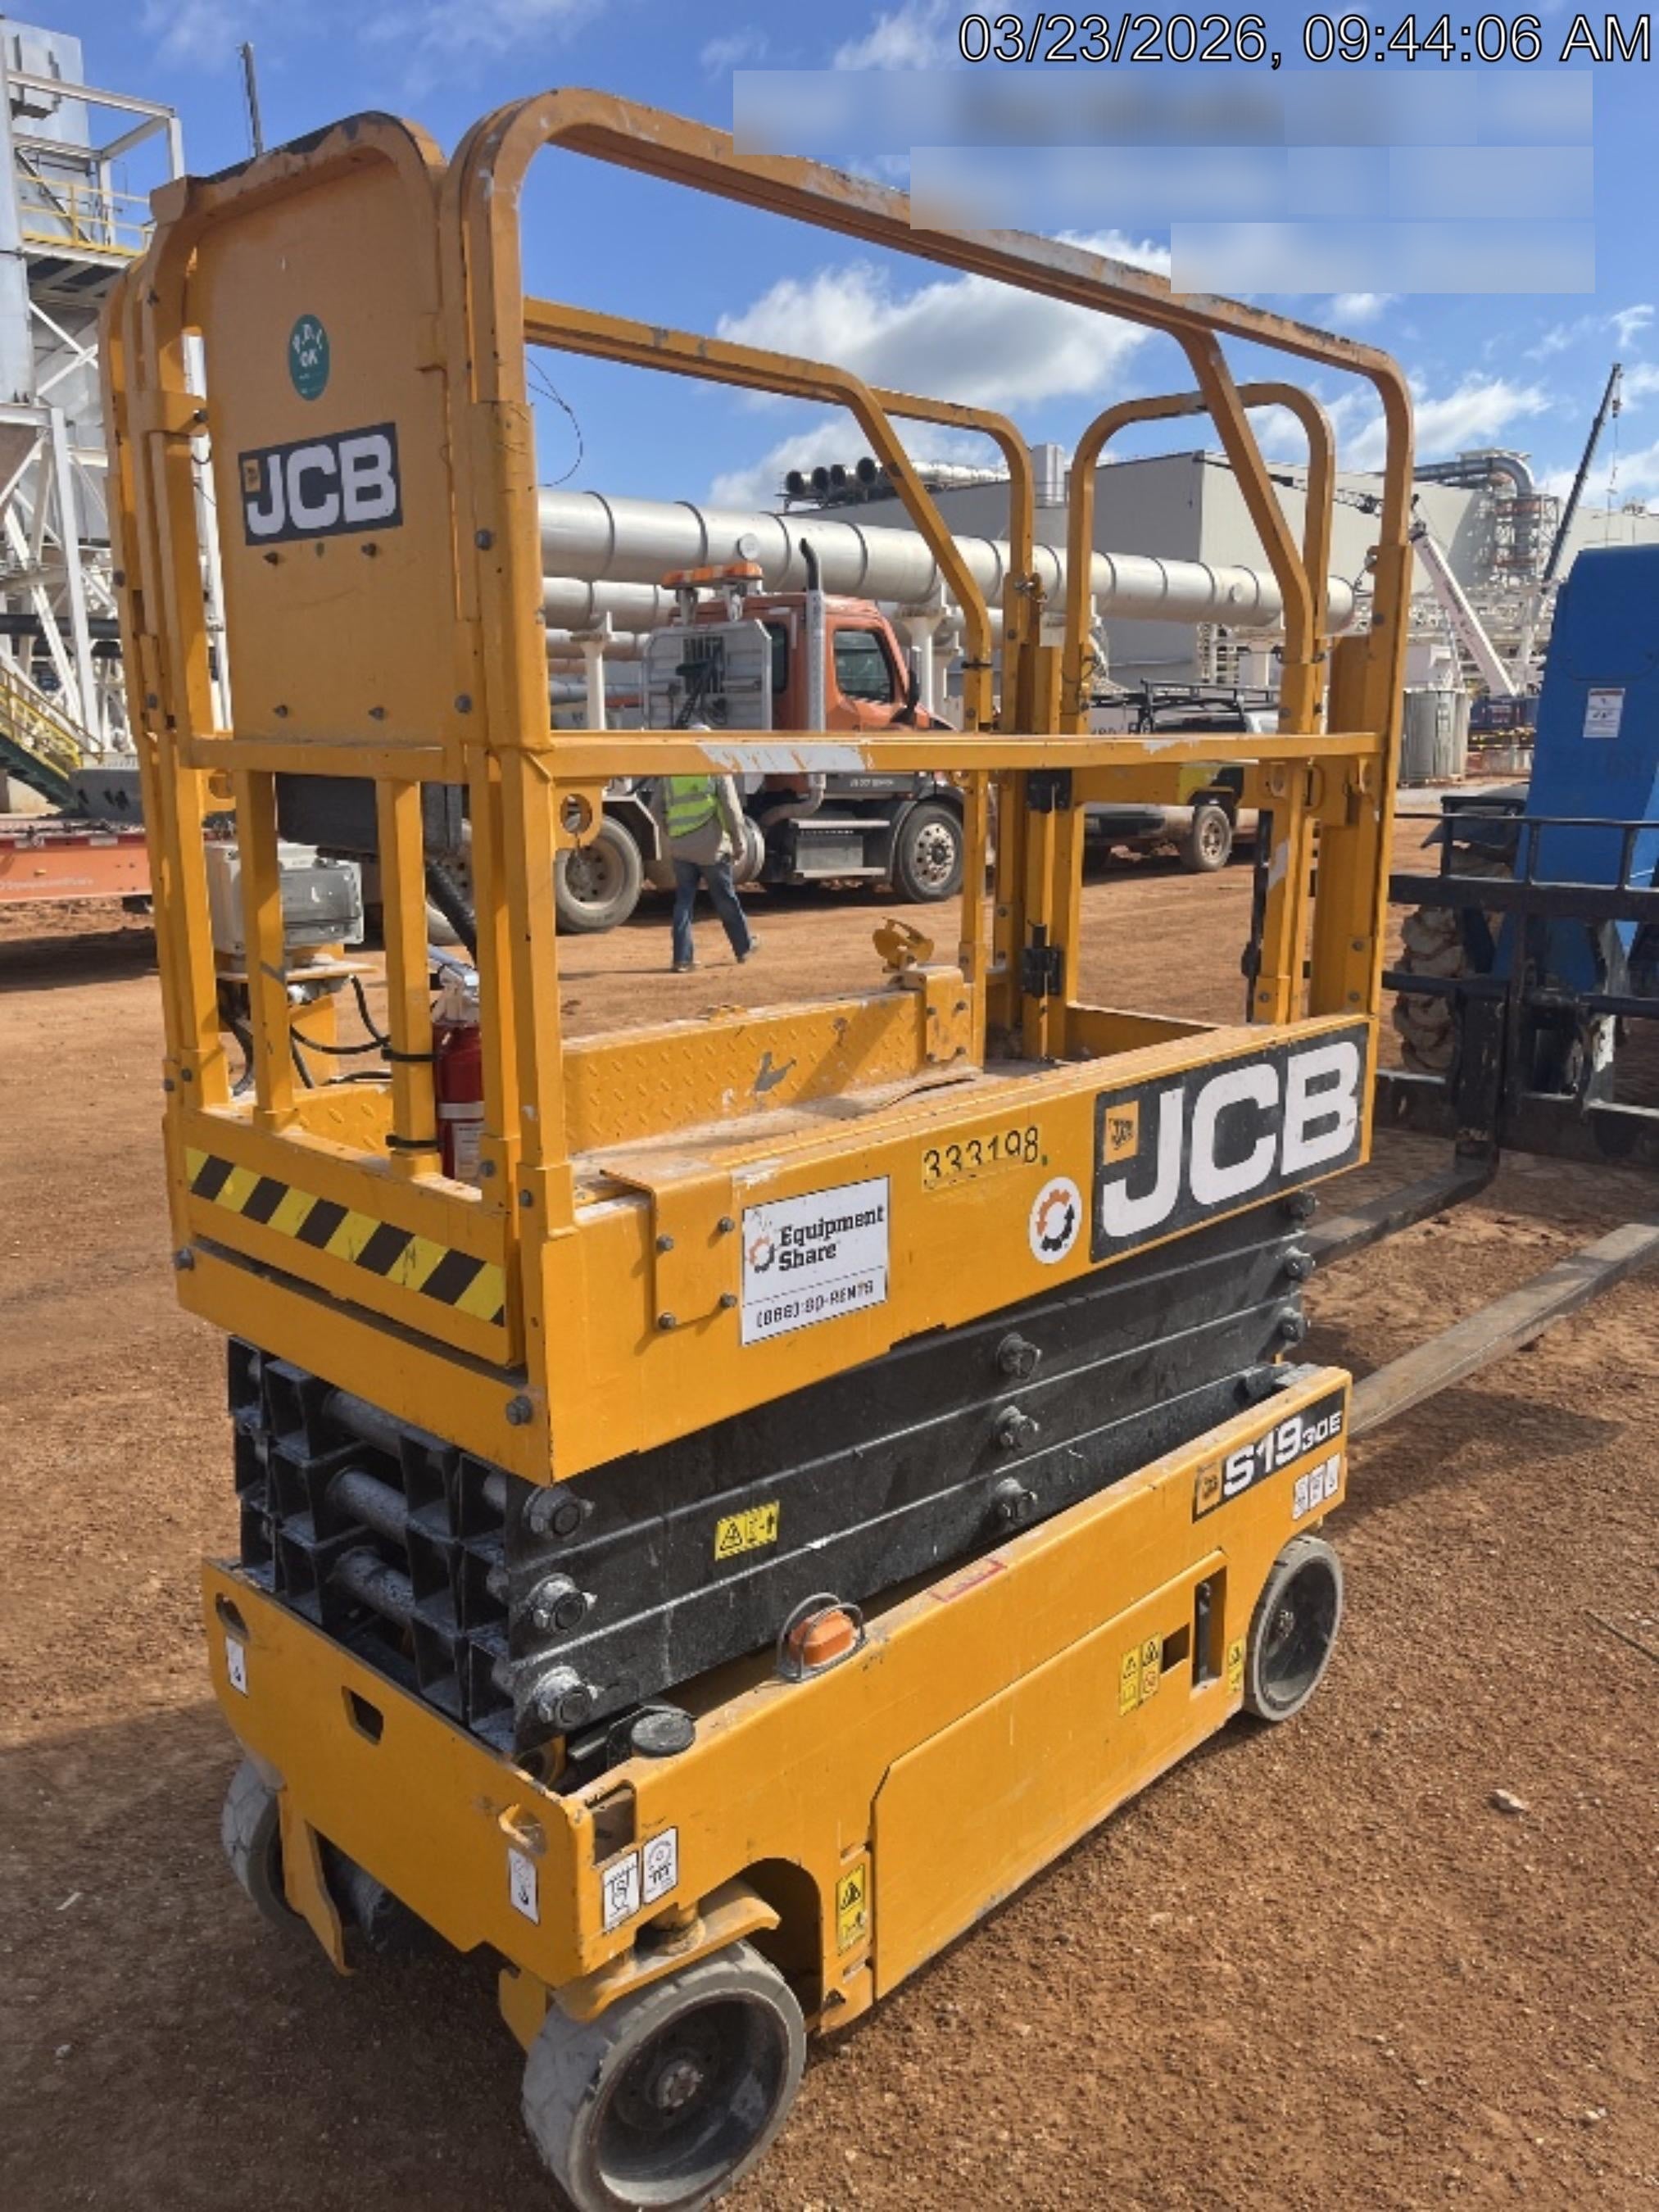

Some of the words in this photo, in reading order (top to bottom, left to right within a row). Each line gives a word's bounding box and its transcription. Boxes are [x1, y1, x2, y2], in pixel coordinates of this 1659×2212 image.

[247, 434, 397, 536] JCB
[1103, 1041, 1360, 1237] JCB
[778, 1243, 836, 1271] Share
[780, 1204, 884, 1247] Equipment
